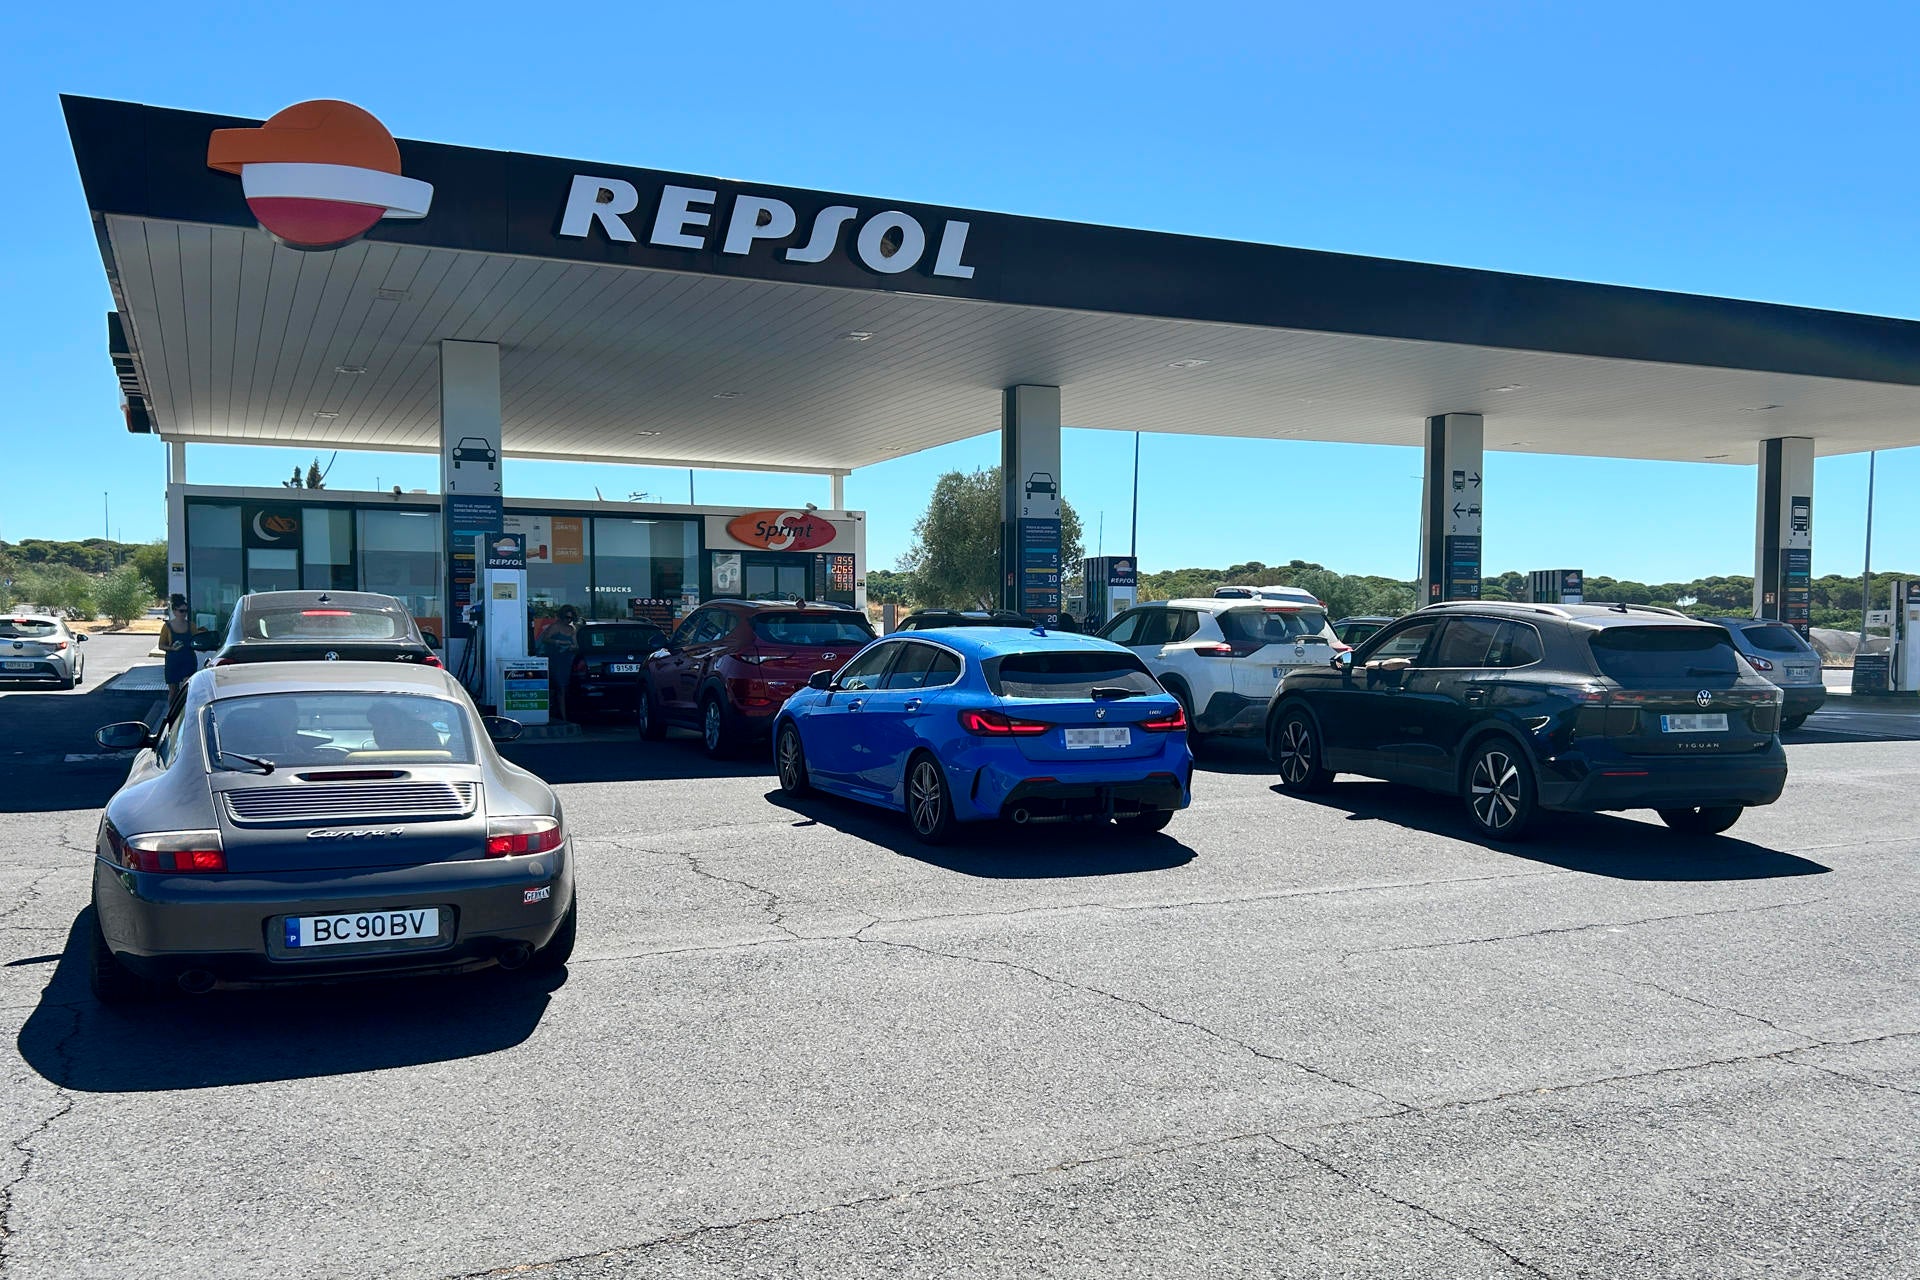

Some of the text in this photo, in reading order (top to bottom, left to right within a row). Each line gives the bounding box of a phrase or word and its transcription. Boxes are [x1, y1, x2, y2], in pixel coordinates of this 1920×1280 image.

[560, 174, 975, 279] REPSOL
[449, 480, 456, 491] 1
[494, 482, 501, 492] 2
[1023, 507, 1029, 516] 3
[1054, 508, 1060, 516] 4
[754, 520, 814, 541] Sprint
[1452, 525, 1457, 533] 5
[488, 558, 524, 566] REPSOL
[1052, 554, 1058, 563] 5
[1473, 567, 1479, 575] 5
[1047, 574, 1058, 583] 10
[1048, 594, 1058, 603] 15
[1047, 614, 1058, 623] 20
[307, 826, 405, 838] Carrera 4
[290, 911, 426, 943] P BC 90 BV
